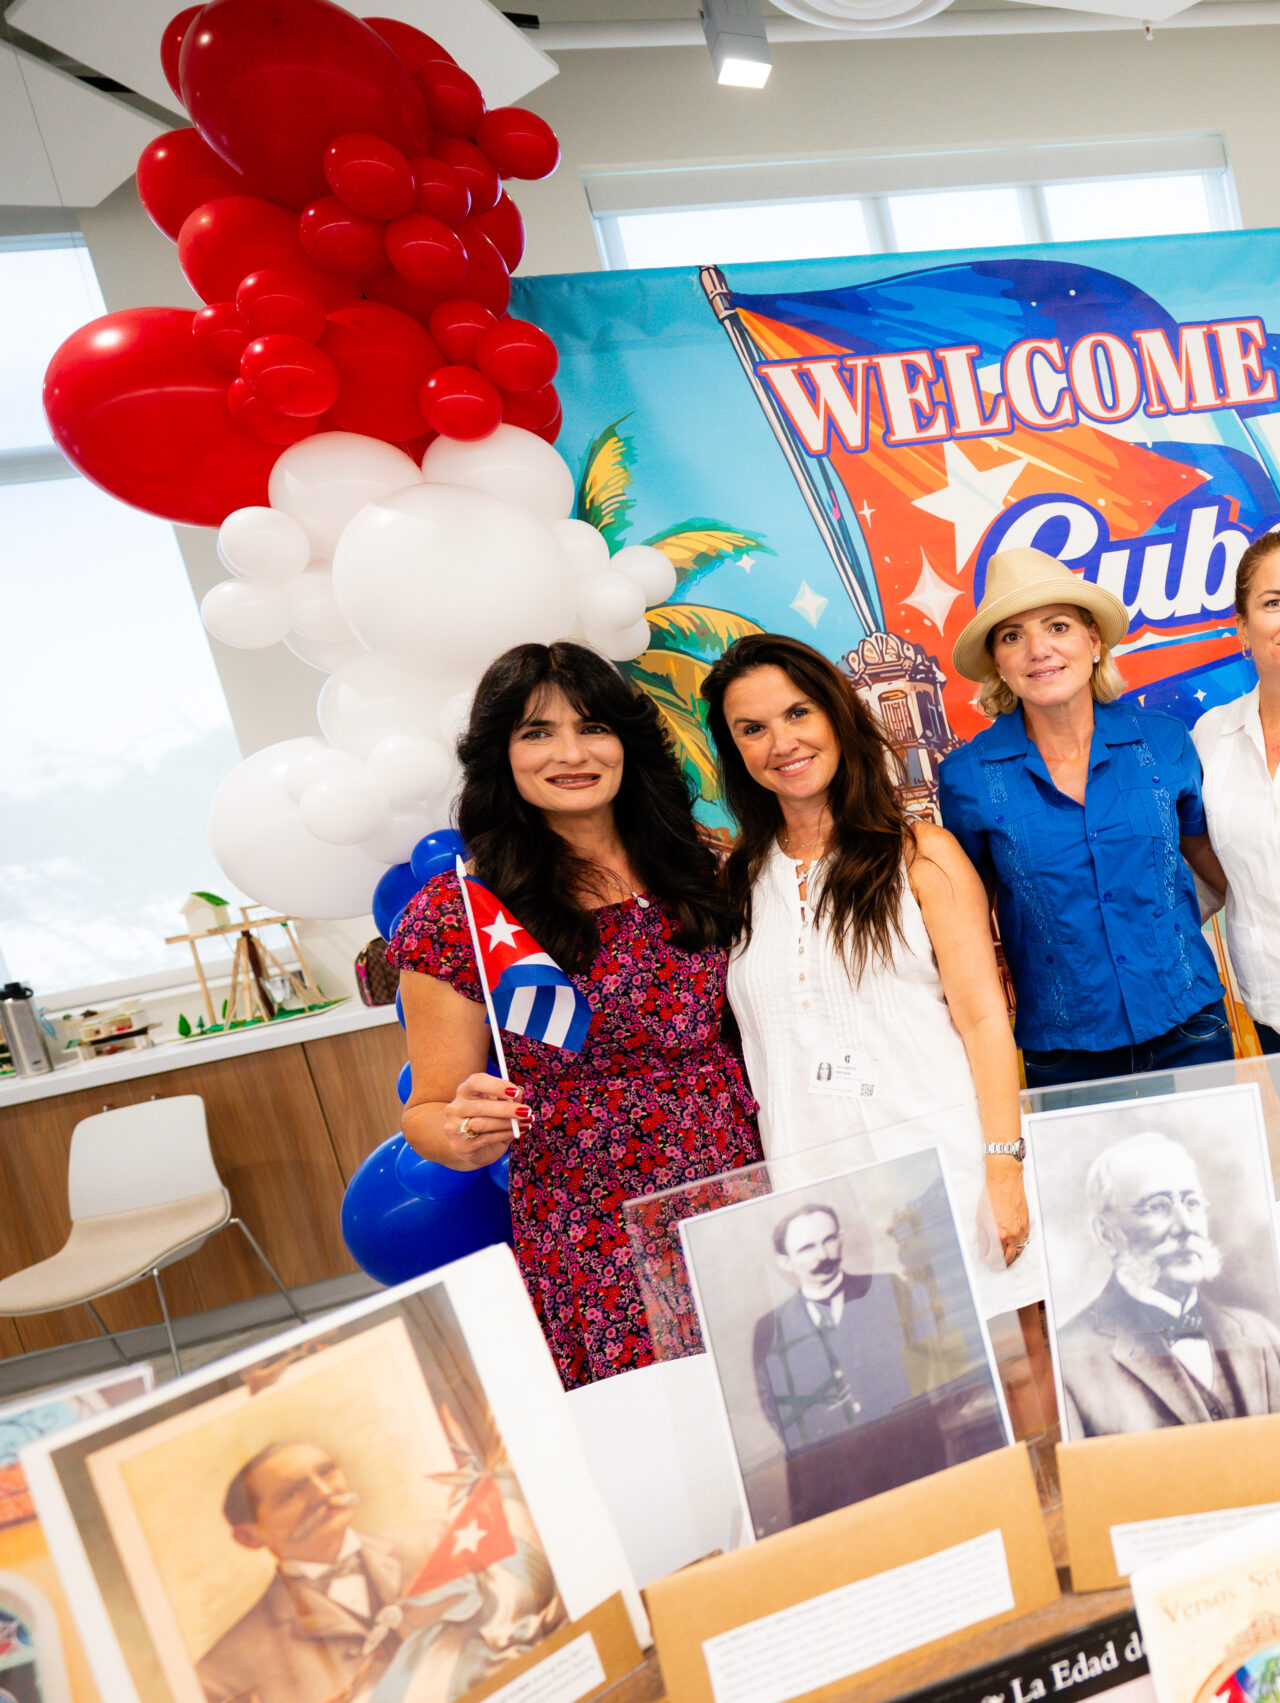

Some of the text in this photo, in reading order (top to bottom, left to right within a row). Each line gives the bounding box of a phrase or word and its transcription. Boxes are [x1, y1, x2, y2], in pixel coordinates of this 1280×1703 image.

[758, 315, 1279, 456] WELCOME
[1160, 1587, 1237, 1623] Versos
[1009, 1676, 1047, 1703] La
[1050, 1640, 1120, 1692] Edad
[1124, 1630, 1148, 1662] d
